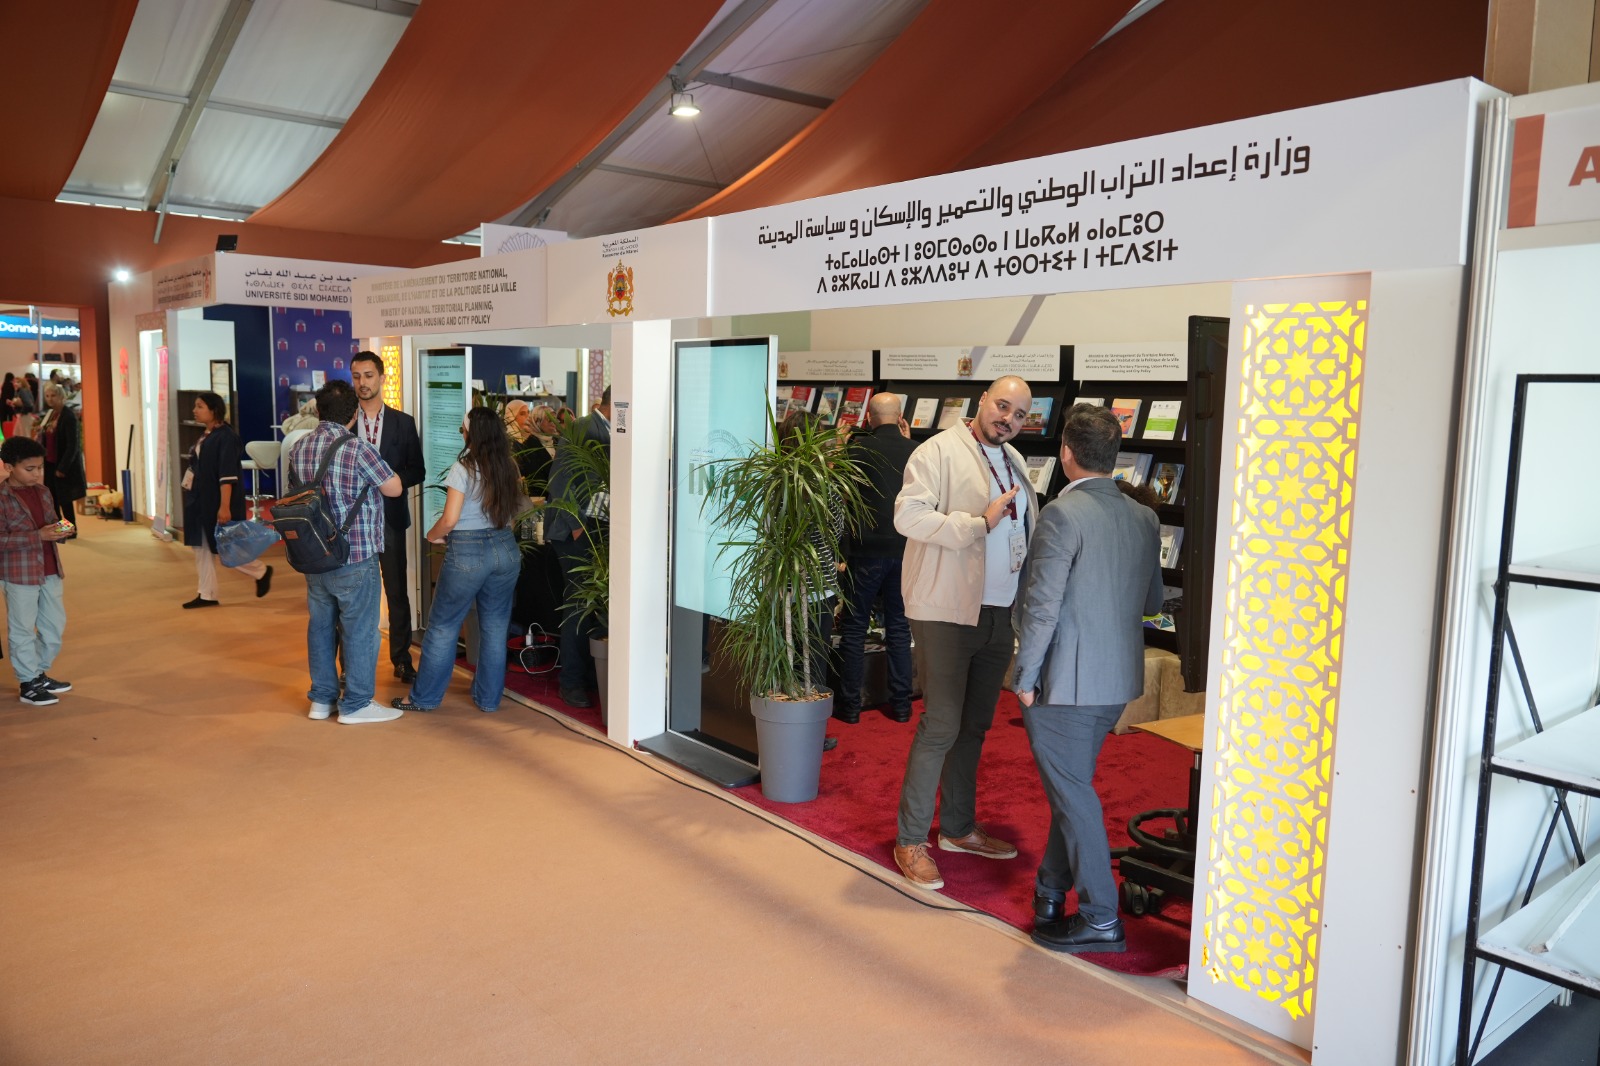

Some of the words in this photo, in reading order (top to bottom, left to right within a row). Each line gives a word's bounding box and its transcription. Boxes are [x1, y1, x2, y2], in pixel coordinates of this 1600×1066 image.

[1172, 145, 1237, 182] إعداد
[1244, 136, 1310, 179] وزارة
[1101, 158, 1165, 199] التراب
[1018, 170, 1095, 214] الوطني
[936, 186, 1013, 226] والتعمير
[862, 200, 931, 236] والإسكان
[758, 220, 803, 249] المدينة
[276, 270, 291, 278] الله
[294, 273, 317, 281] عبد
[320, 273, 333, 283] بن
[439, 275, 446, 284] DU
[447, 271, 477, 284] TERRITOIRE
[478, 268, 508, 280] NATIONAL,
[245, 290, 291, 300] UNIVERSITÉ
[293, 292, 308, 301] SIDI
[310, 294, 349, 304] MOHAMED
[432, 289, 438, 299] ET
[439, 288, 446, 297] DE
[446, 287, 453, 297] LA
[454, 285, 482, 297] POLITIQUE
[483, 284, 490, 294] DE
[491, 283, 499, 293] LA
[500, 282, 517, 292] VILLE
[381, 308, 401, 317] MINISTRY
[401, 307, 408, 316] OF
[408, 306, 431, 315] NATIONAL
[432, 303, 464, 314] TERRITORIAL
[464, 301, 494, 312] PLANNING,
[384, 319, 399, 328] URBAN
[399, 318, 423, 328] PLANNING,
[424, 316, 446, 327] HOUSING
[446, 316, 457, 326] AND
[458, 315, 470, 325] CITY
[471, 314, 491, 325] POLICY
